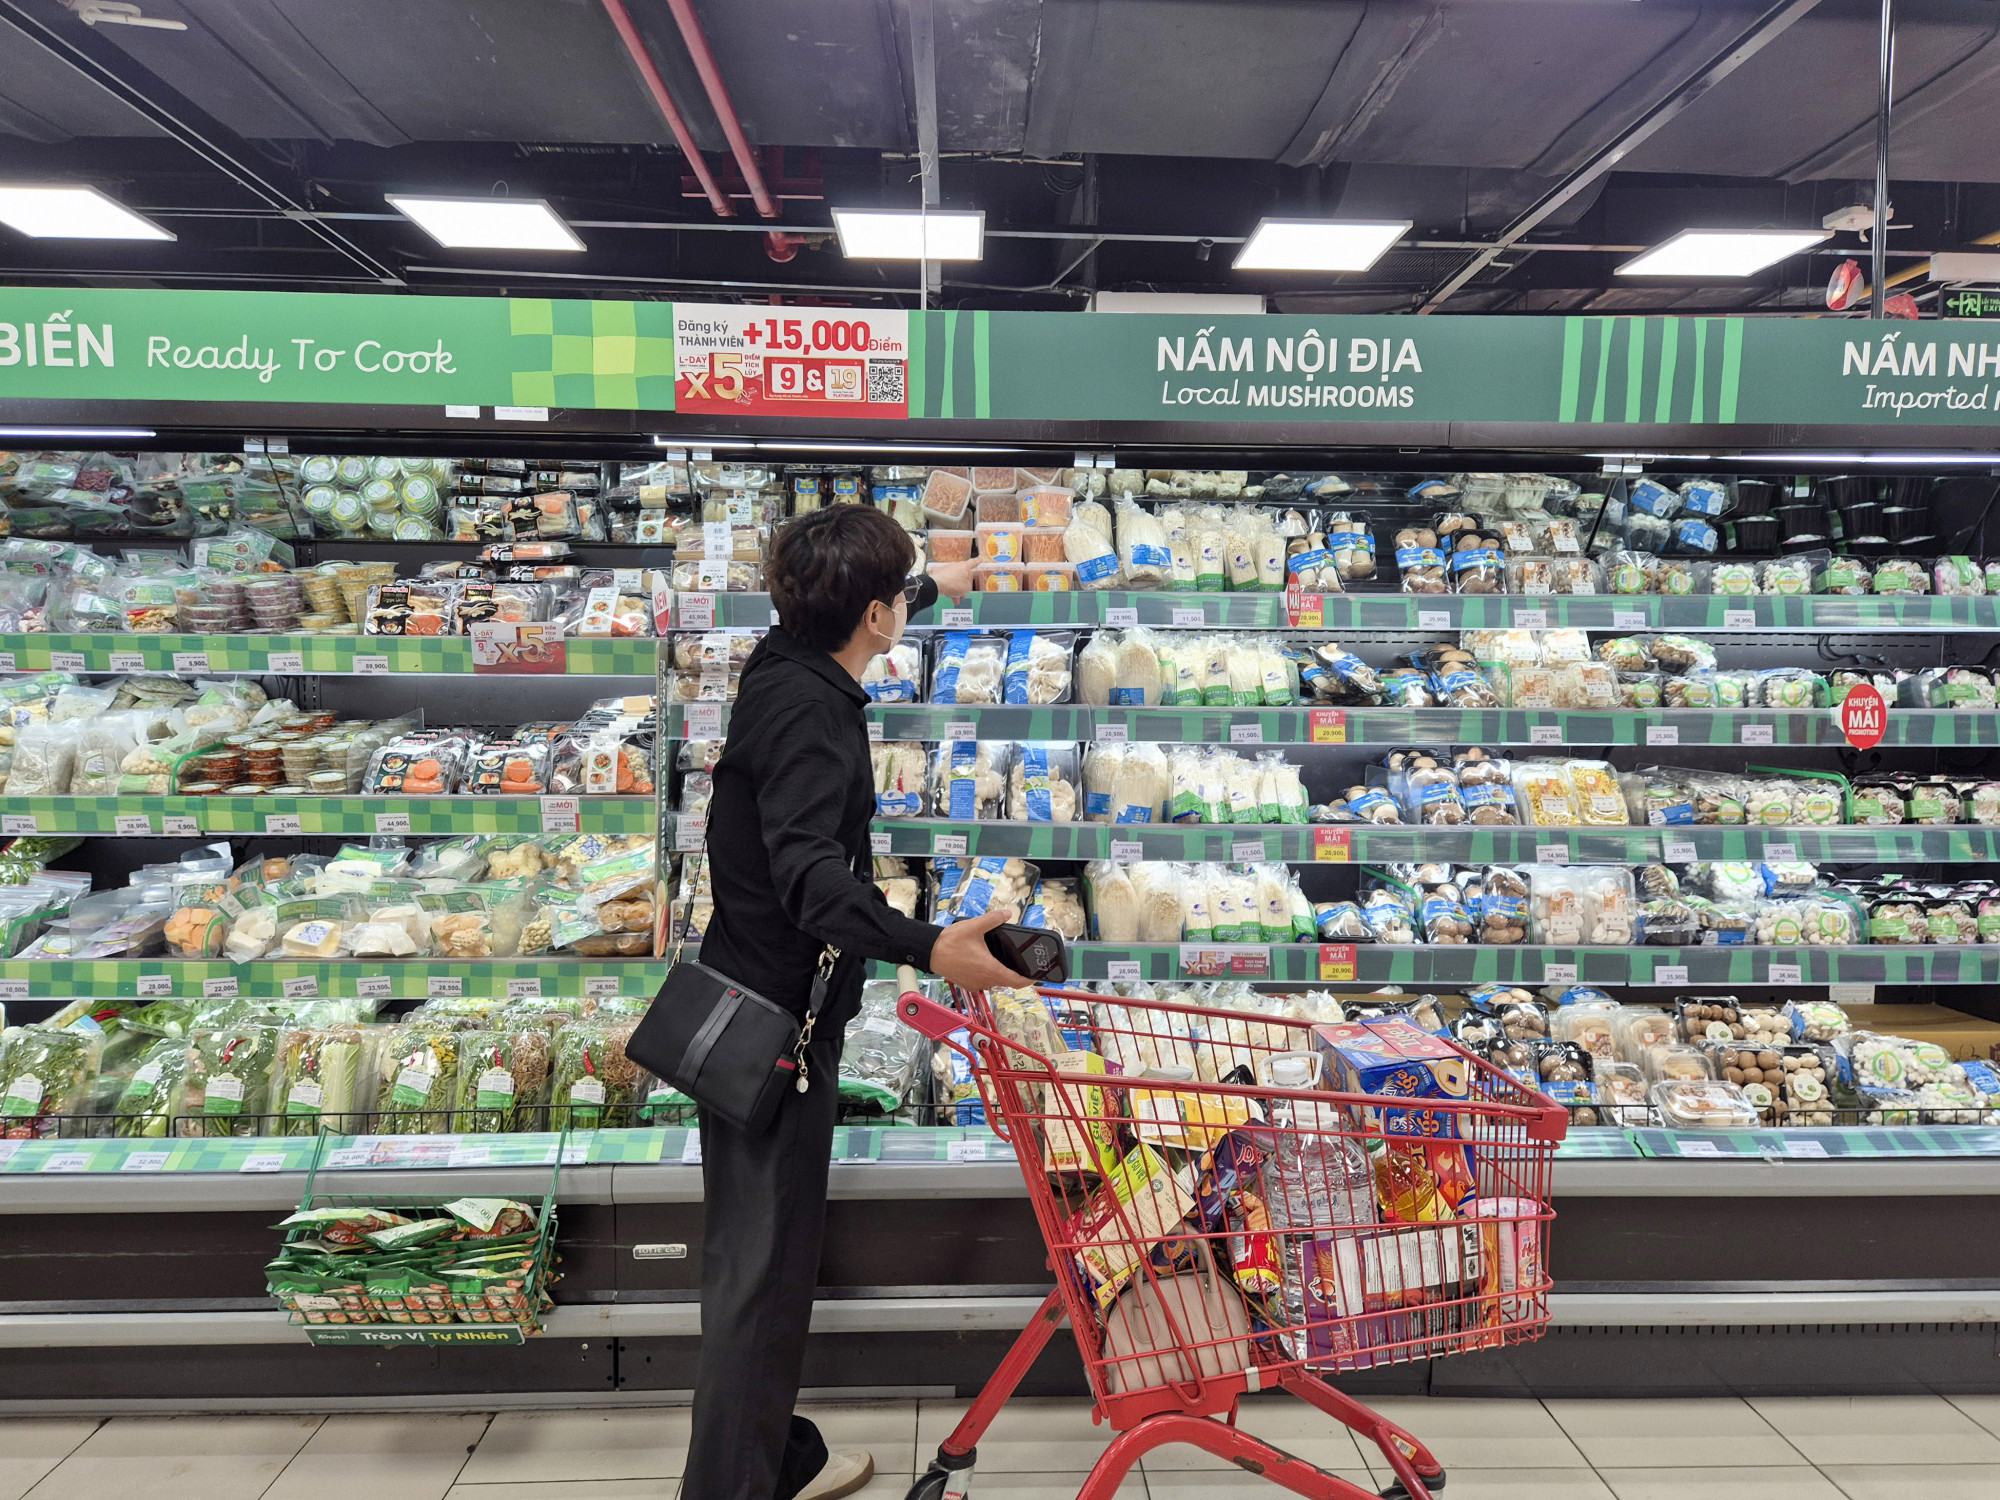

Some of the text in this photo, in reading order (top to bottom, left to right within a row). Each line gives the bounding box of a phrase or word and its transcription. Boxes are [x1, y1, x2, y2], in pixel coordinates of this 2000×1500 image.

[678, 320, 728, 335] Đăng ký
[679, 335, 744, 348] THÀNH VIÊN
[743, 319, 902, 355] +15,000 Điểm
[0, 309, 457, 383] BIẾN Ready To Cook
[679, 356, 708, 364] L-DAY
[1157, 326, 1423, 382] NẤM NỘI ĐỊA
[1842, 331, 1936, 377] NẤM
[681, 353, 744, 399] x5
[780, 367, 857, 391] 9 & 19
[1162, 378, 1414, 408] Local MUSHROOMS
[1861, 384, 1989, 418] Imported
[1848, 695, 1879, 708] KHUYẾN
[1848, 706, 1879, 728] MÃI
[1394, 1069, 1418, 1098] iger
[405, 1332, 425, 1342] Vị
[428, 1331, 451, 1343] Tự
[455, 1331, 509, 1342] Nhiên
